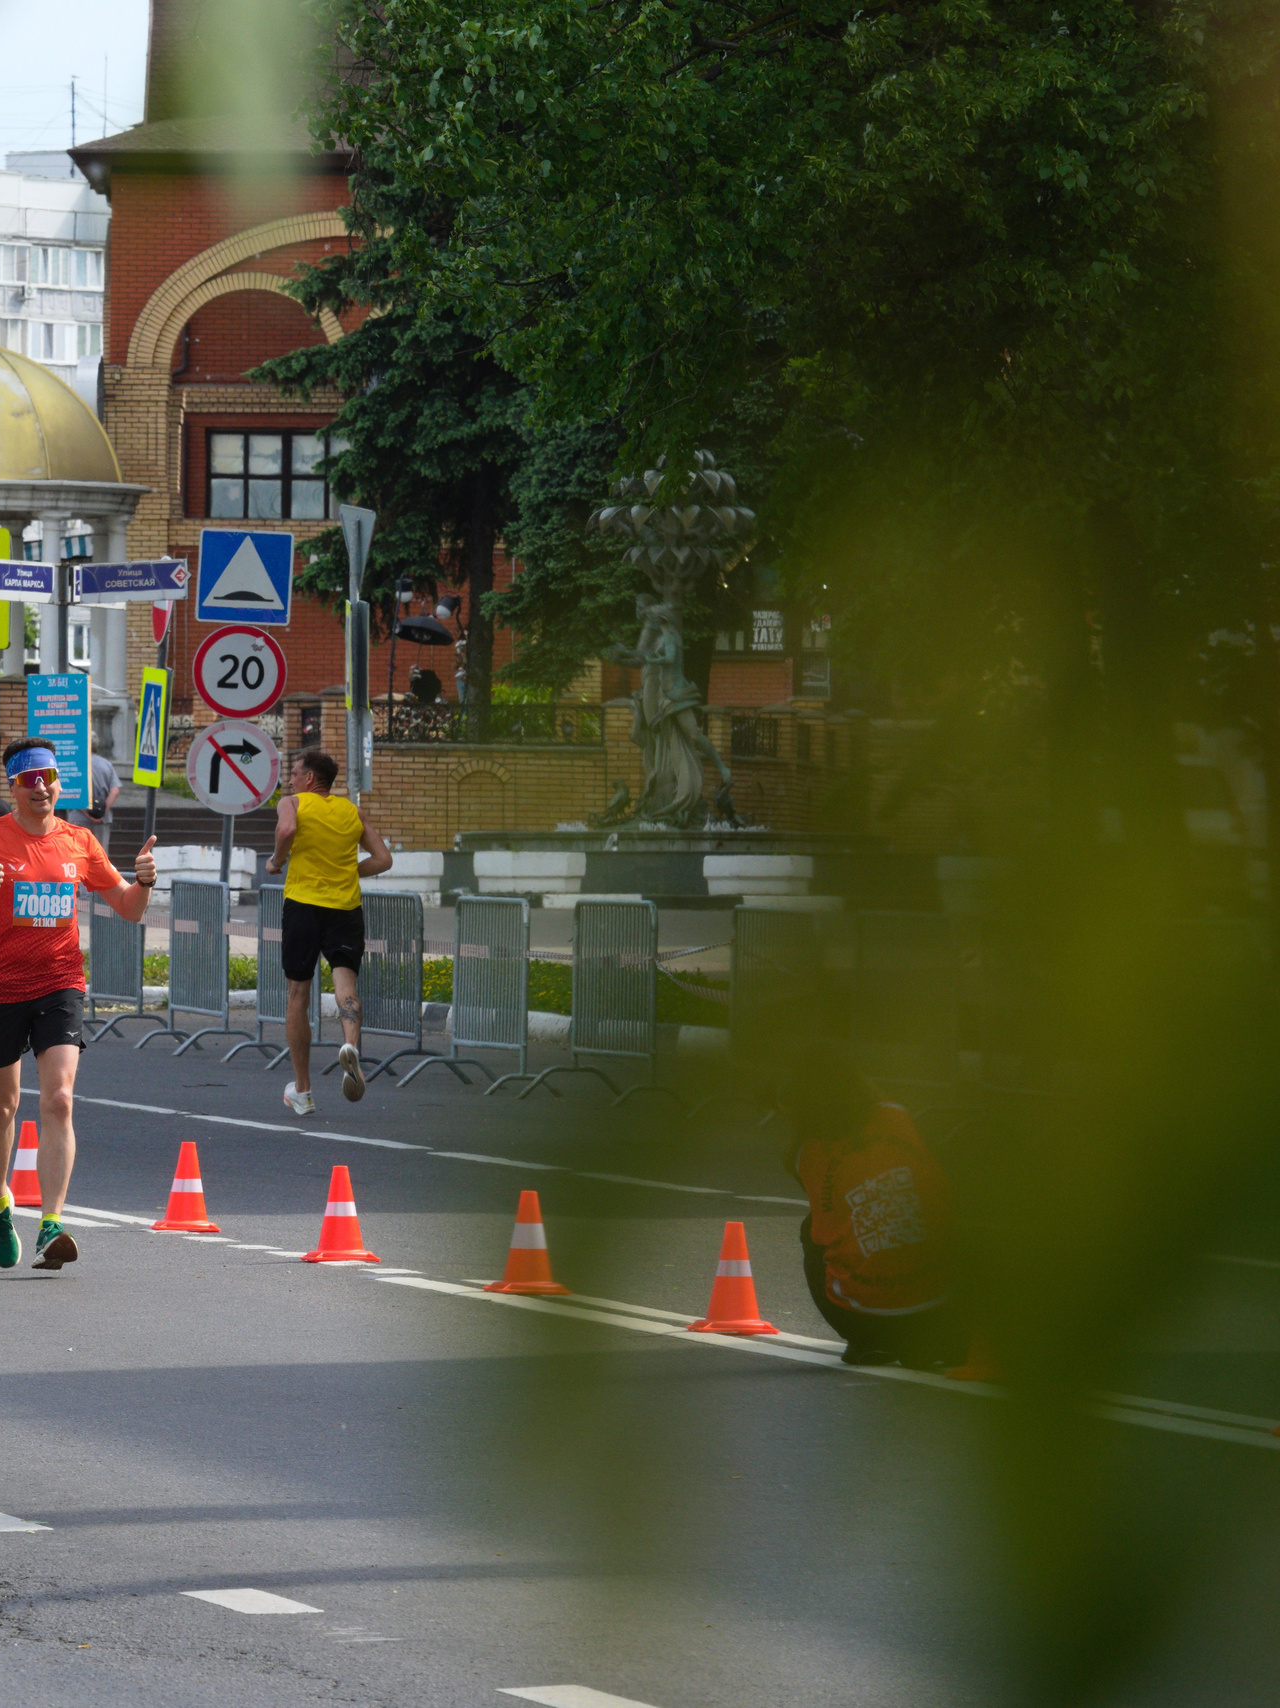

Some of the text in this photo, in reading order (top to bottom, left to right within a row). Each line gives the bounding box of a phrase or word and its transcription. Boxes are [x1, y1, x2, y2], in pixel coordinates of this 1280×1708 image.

[17, 568, 33, 577] Улица
[117, 568, 143, 578] Улица
[4, 579, 45, 589] КАРЛА МАРКСА
[105, 578, 156, 589] СОВЕТСКАЯ
[217, 654, 265, 690] 20
[62, 863, 76, 878] 10
[17, 894, 72, 917] 70089
[32, 918, 57, 928] 21.1KM
